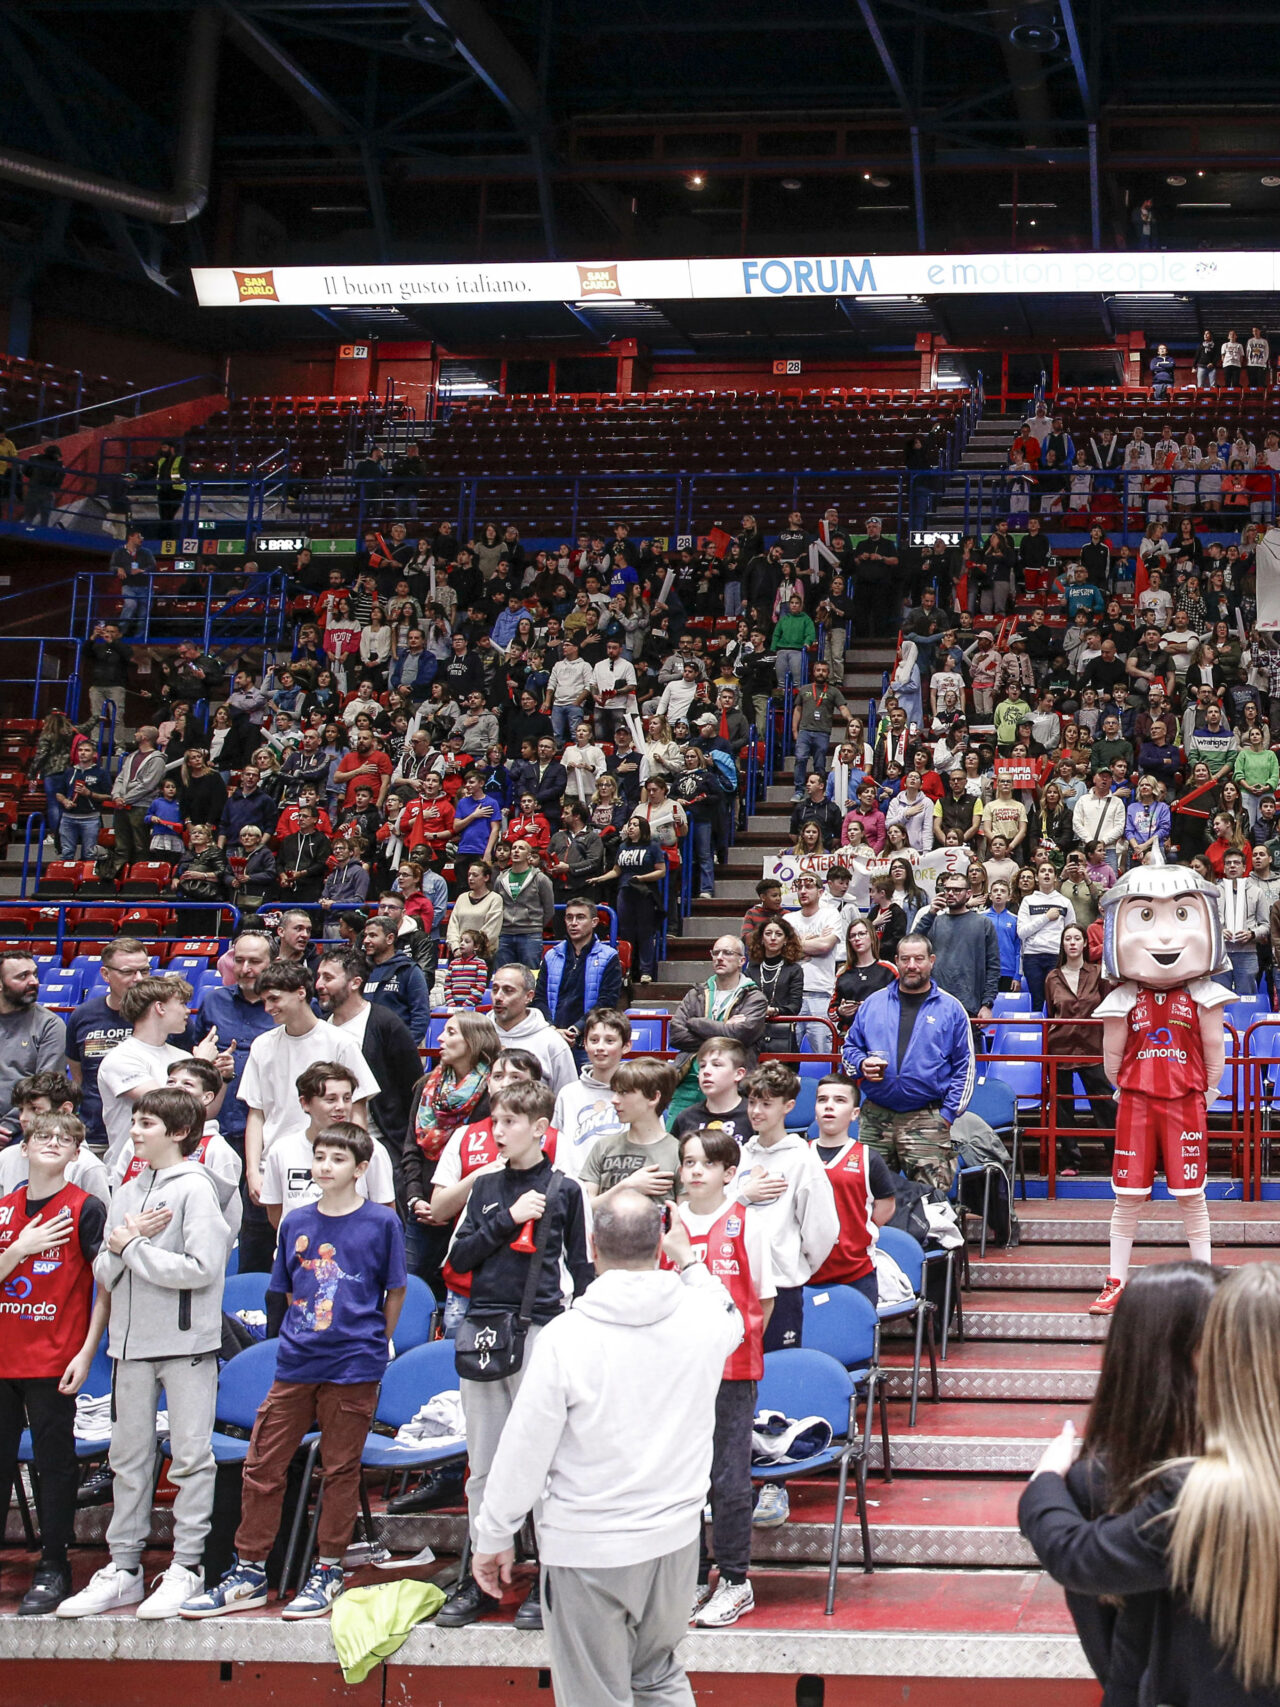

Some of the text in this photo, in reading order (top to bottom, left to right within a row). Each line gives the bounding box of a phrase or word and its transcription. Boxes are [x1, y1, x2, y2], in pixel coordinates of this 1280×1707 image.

[587, 272, 609, 281] SAN
[743, 259, 877, 294] FORUM
[928, 256, 1185, 292] e motion people
[244, 278, 266, 286] SAN
[324, 274, 531, 300] Il buon gusto italiano.
[582, 281, 616, 291] CARLO
[240, 286, 274, 295] CARLO
[343, 346, 365, 356] C 27
[775, 362, 800, 372] C 28
[184, 541, 197, 551] 27
[268, 539, 293, 551] BAR
[678, 538, 690, 548] 28
[618, 849, 647, 866] SICILY
[1180, 1131, 1202, 1140] AON
[468, 1132, 484, 1151] 12
[603, 1157, 647, 1170] DARE
[1184, 1164, 1198, 1180] 36
[33, 1263, 56, 1271] SAP
